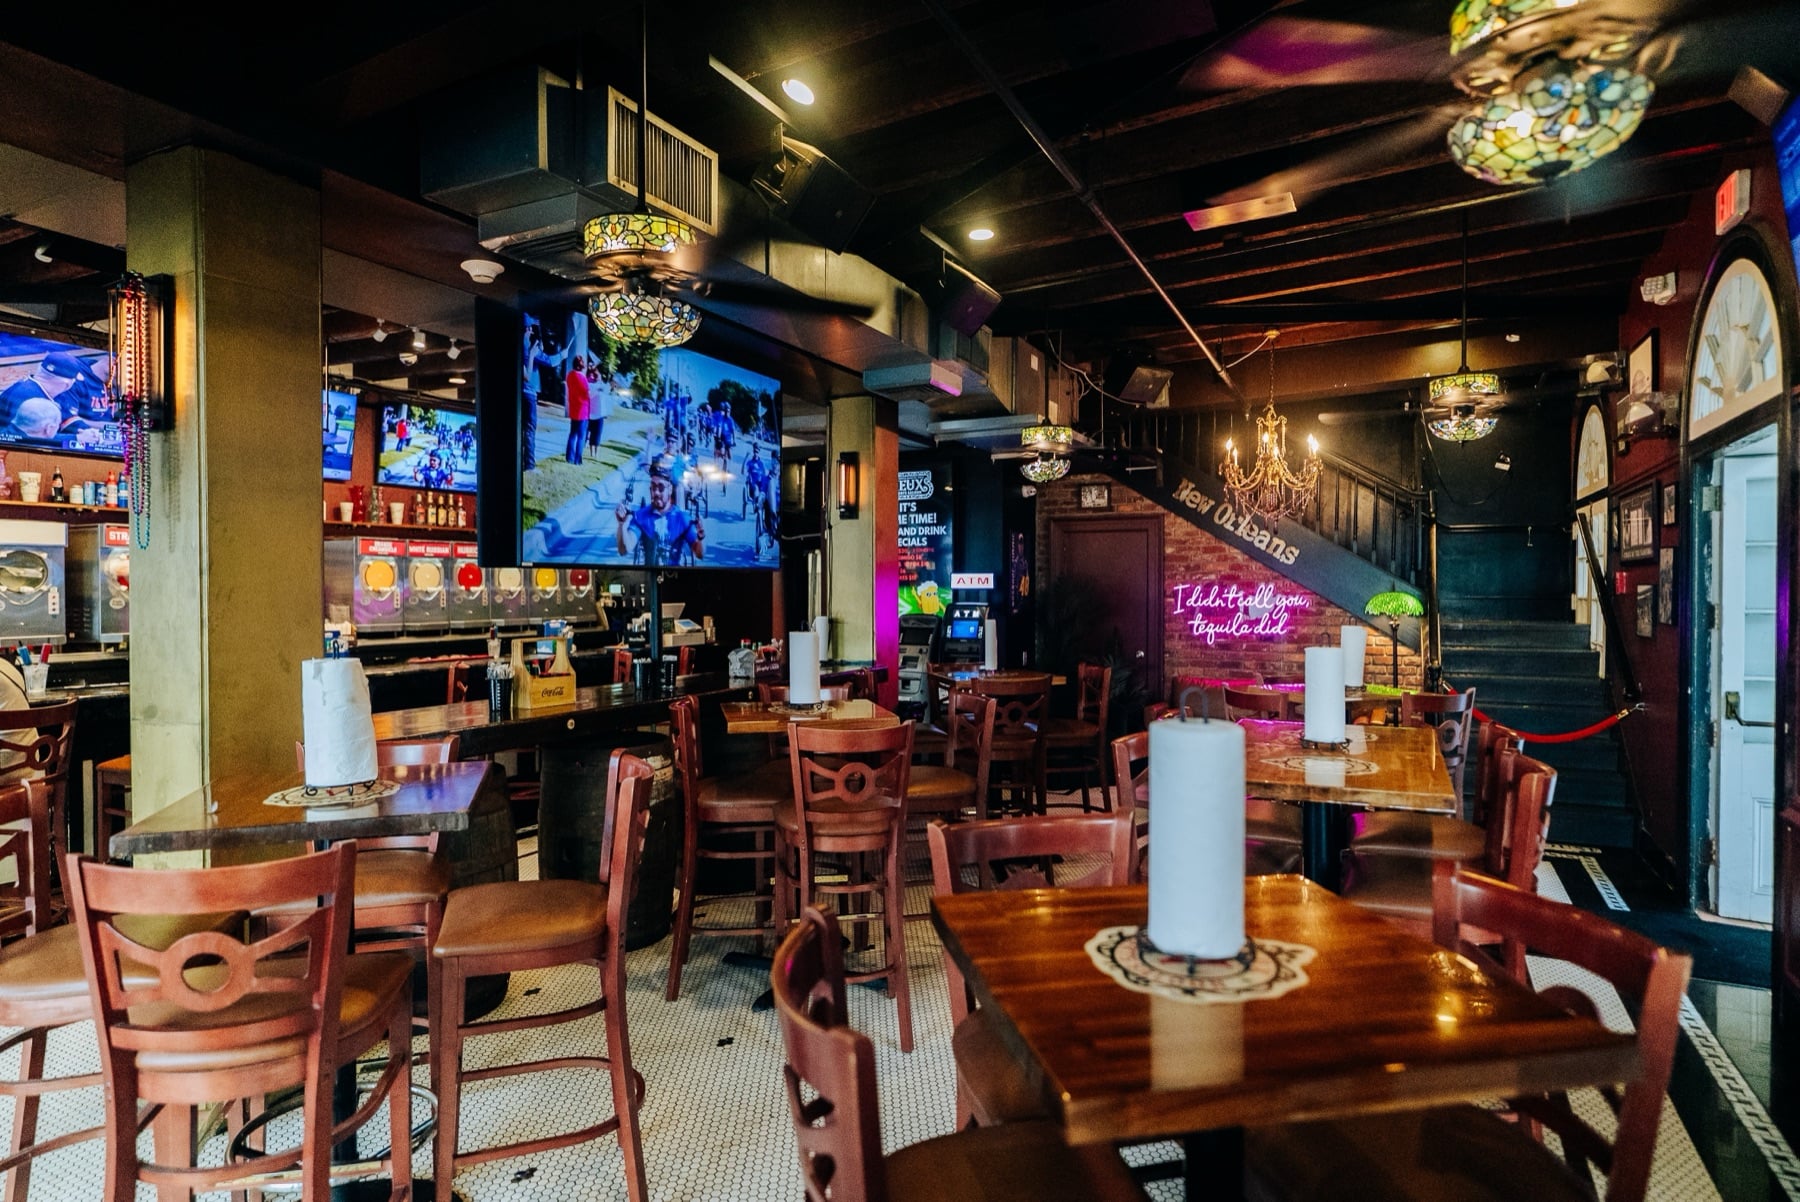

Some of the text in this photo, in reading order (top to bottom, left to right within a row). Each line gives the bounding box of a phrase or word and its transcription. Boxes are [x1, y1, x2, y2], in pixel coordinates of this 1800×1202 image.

[899, 502, 917, 512] IT'S
[909, 512, 937, 525] TIME!
[1172, 478, 1300, 565] New Orleans
[898, 525, 947, 536] AND DRINK
[956, 577, 989, 585] ATM
[1186, 585, 1242, 608] didn't
[1237, 583, 1274, 608] call
[1272, 594, 1310, 620] you,
[953, 609, 980, 618] ATM
[1187, 612, 1289, 645] tequila did
